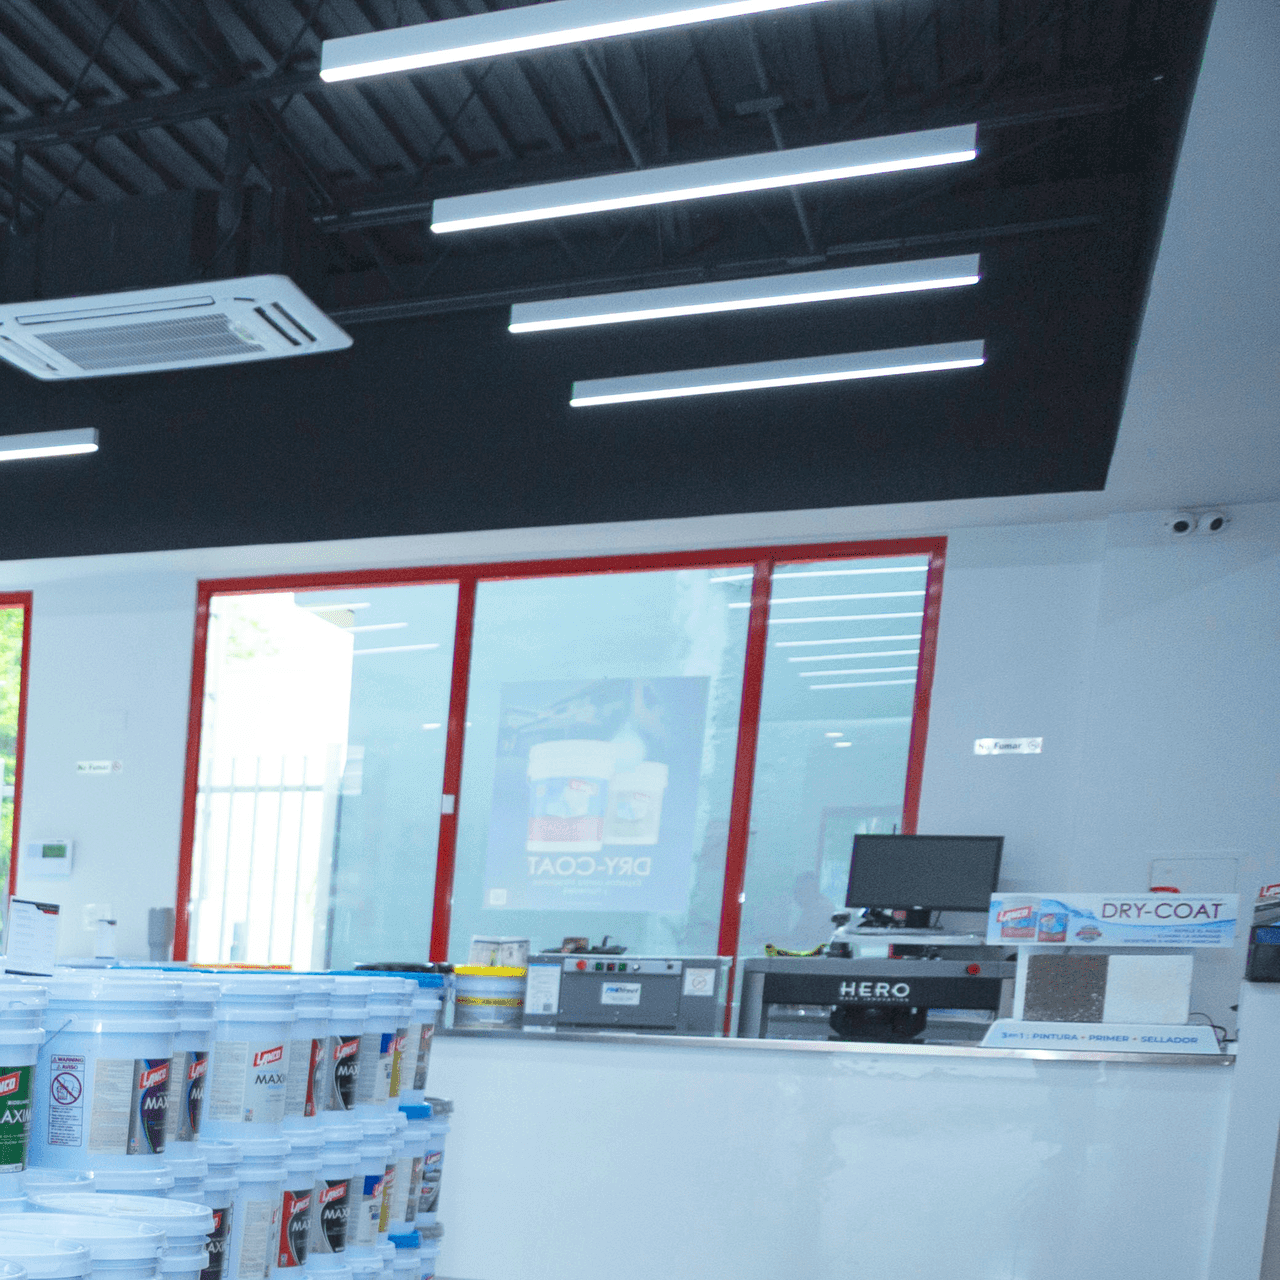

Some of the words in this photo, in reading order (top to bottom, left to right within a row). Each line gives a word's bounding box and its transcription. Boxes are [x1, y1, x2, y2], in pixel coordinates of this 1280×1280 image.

[998, 906, 1032, 922] LANCO
[1102, 903, 1222, 919] DRY-COAT
[841, 982, 910, 997] HERO
[1032, 1033, 1078, 1041] PINTURA
[1089, 1034, 1129, 1042] PRIMER
[257, 1050, 281, 1066] LANCO
[144, 1069, 167, 1087] LANCO
